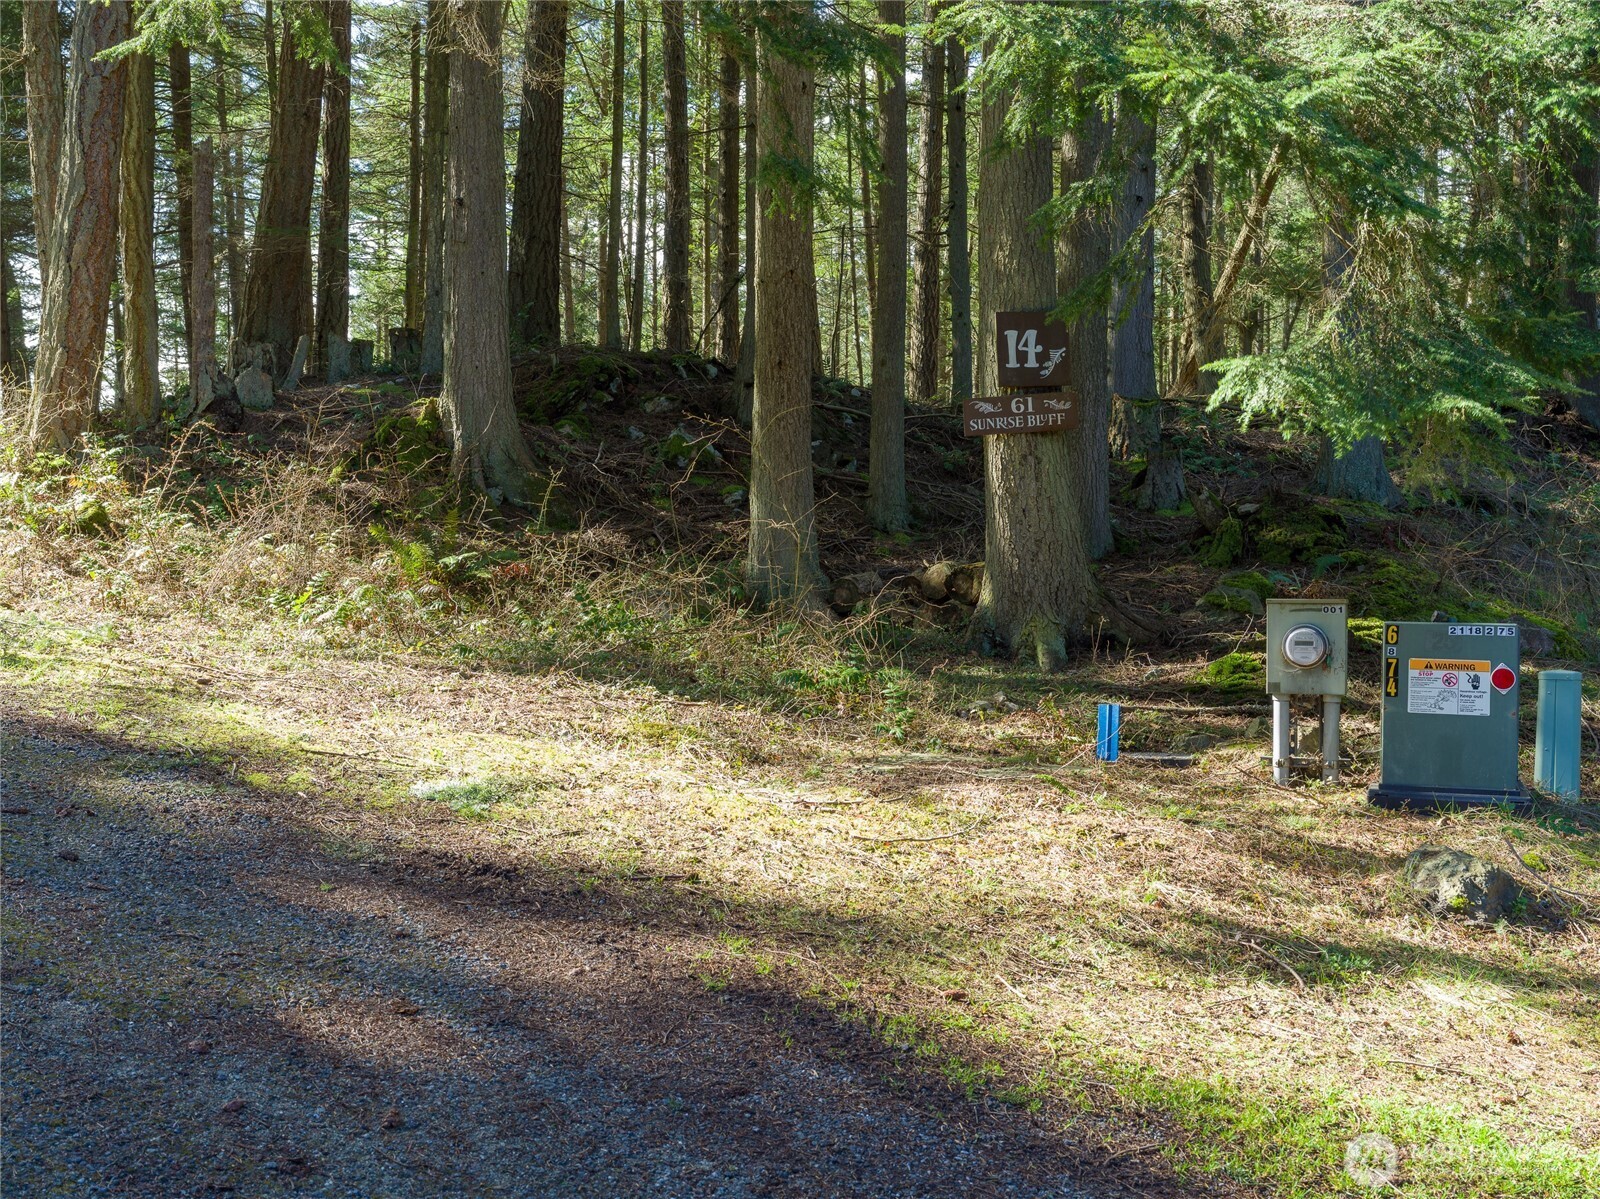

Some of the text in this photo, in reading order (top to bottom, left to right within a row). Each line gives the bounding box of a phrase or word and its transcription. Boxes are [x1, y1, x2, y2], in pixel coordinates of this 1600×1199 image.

[1004, 329, 1043, 368] 14
[1010, 397, 1035, 414] 61
[969, 412, 1066, 431] SUNRISE BLUFF
[1434, 662, 1476, 671] WARNING
